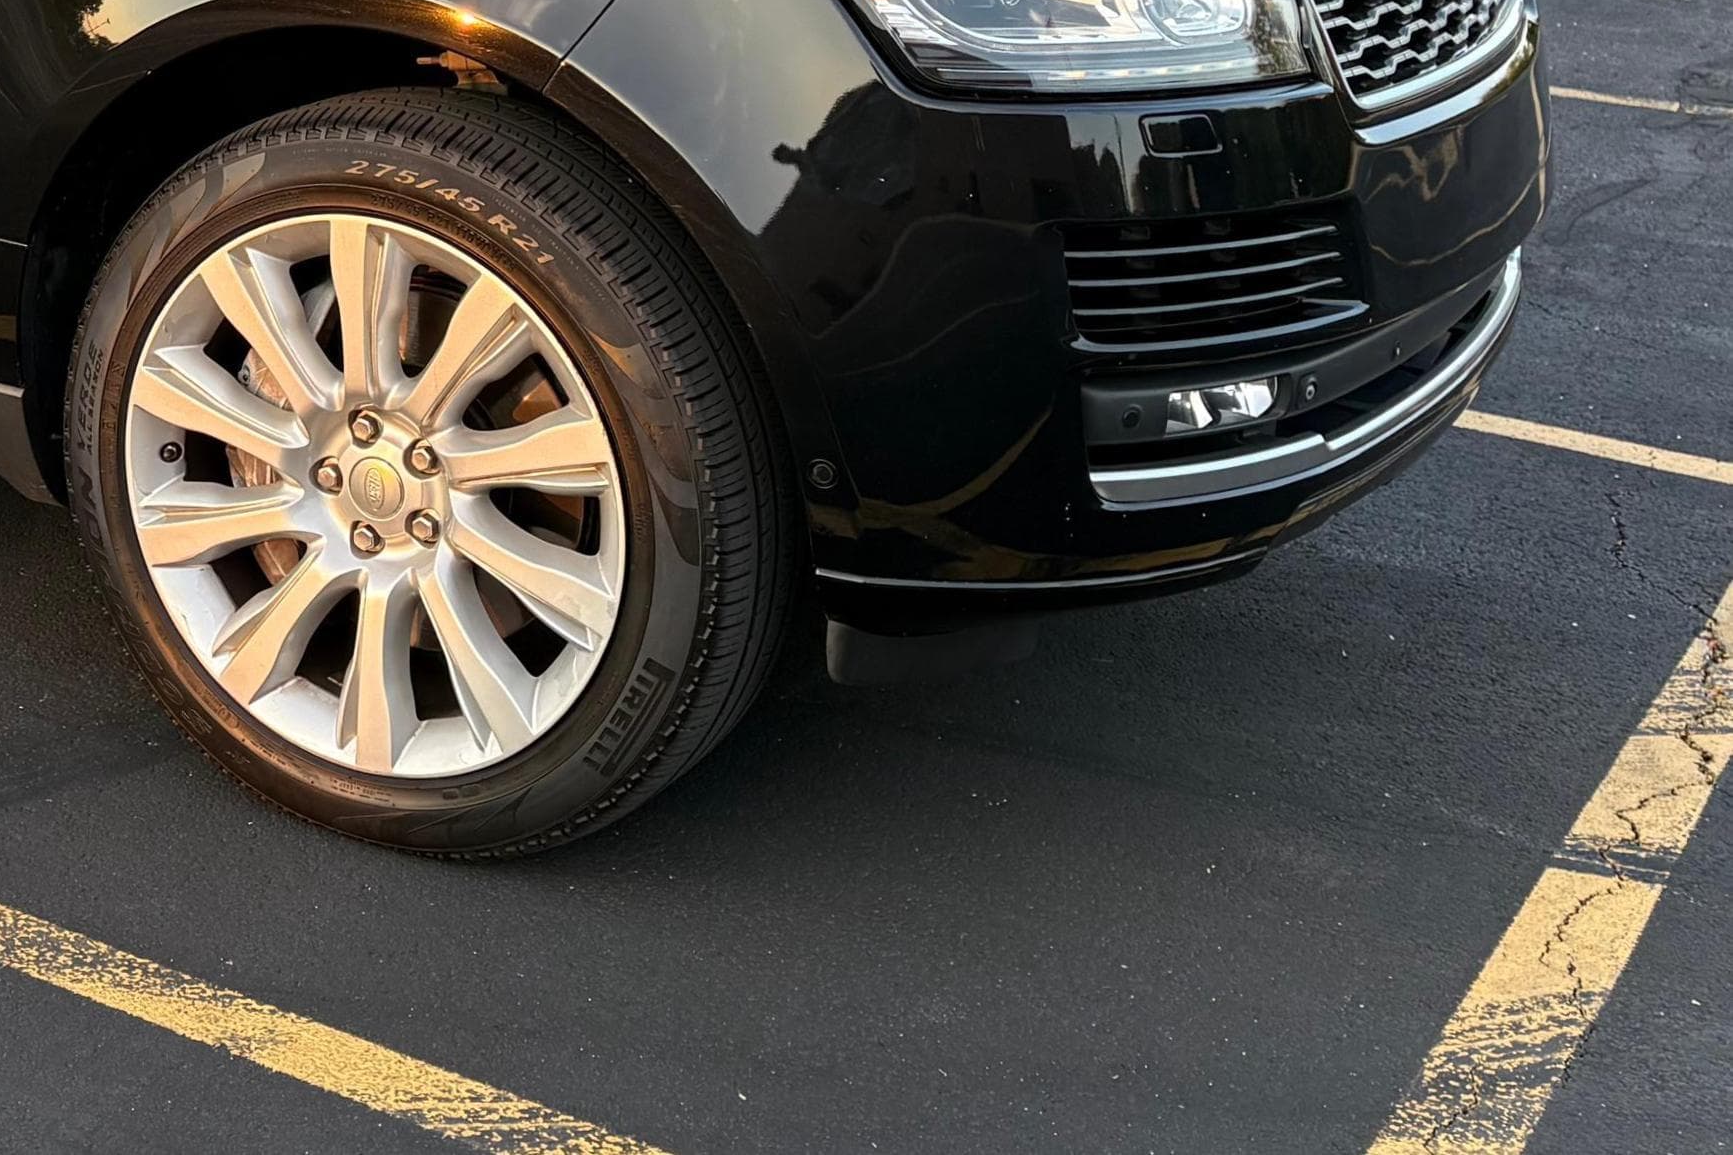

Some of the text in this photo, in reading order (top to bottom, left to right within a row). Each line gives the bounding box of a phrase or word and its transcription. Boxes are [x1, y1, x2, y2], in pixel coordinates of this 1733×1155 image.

[344, 160, 486, 213] 275/45
[76, 339, 97, 451] VERDE
[581, 656, 677, 778] PIRELLI
